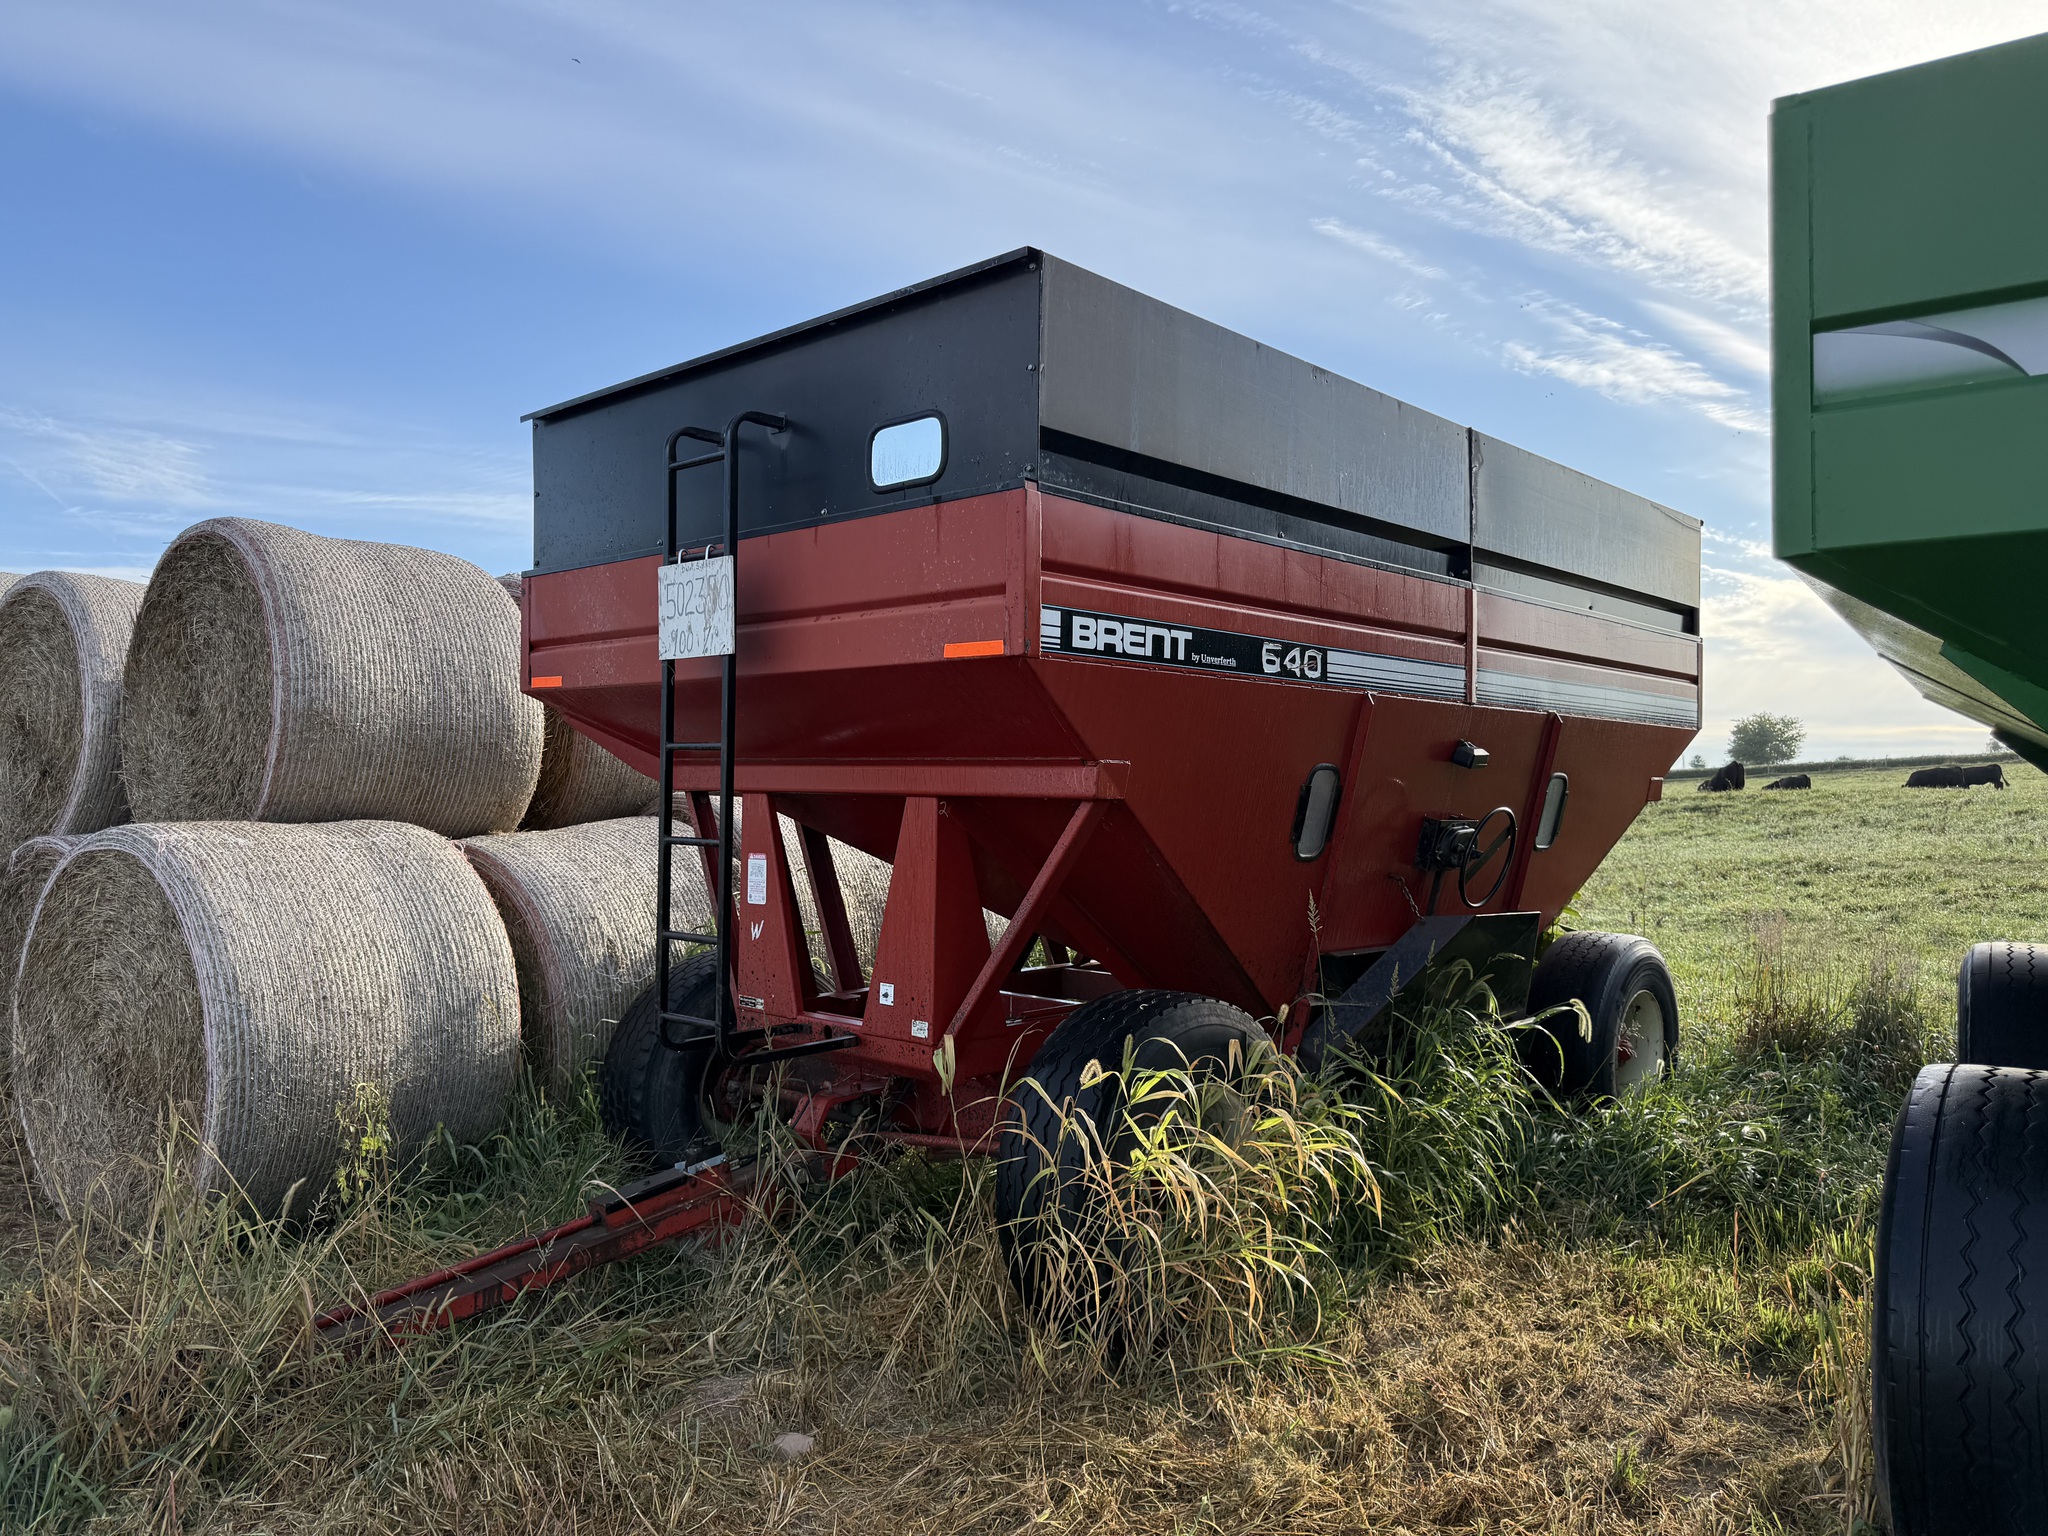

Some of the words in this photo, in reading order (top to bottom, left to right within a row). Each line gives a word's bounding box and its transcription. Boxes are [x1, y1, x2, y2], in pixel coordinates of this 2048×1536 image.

[1072, 615, 1193, 661] BRENT
[1191, 652, 1200, 664] by
[1200, 653, 1237, 667] Unverferth
[1262, 641, 1323, 679] 640
[751, 919, 765, 941] W
